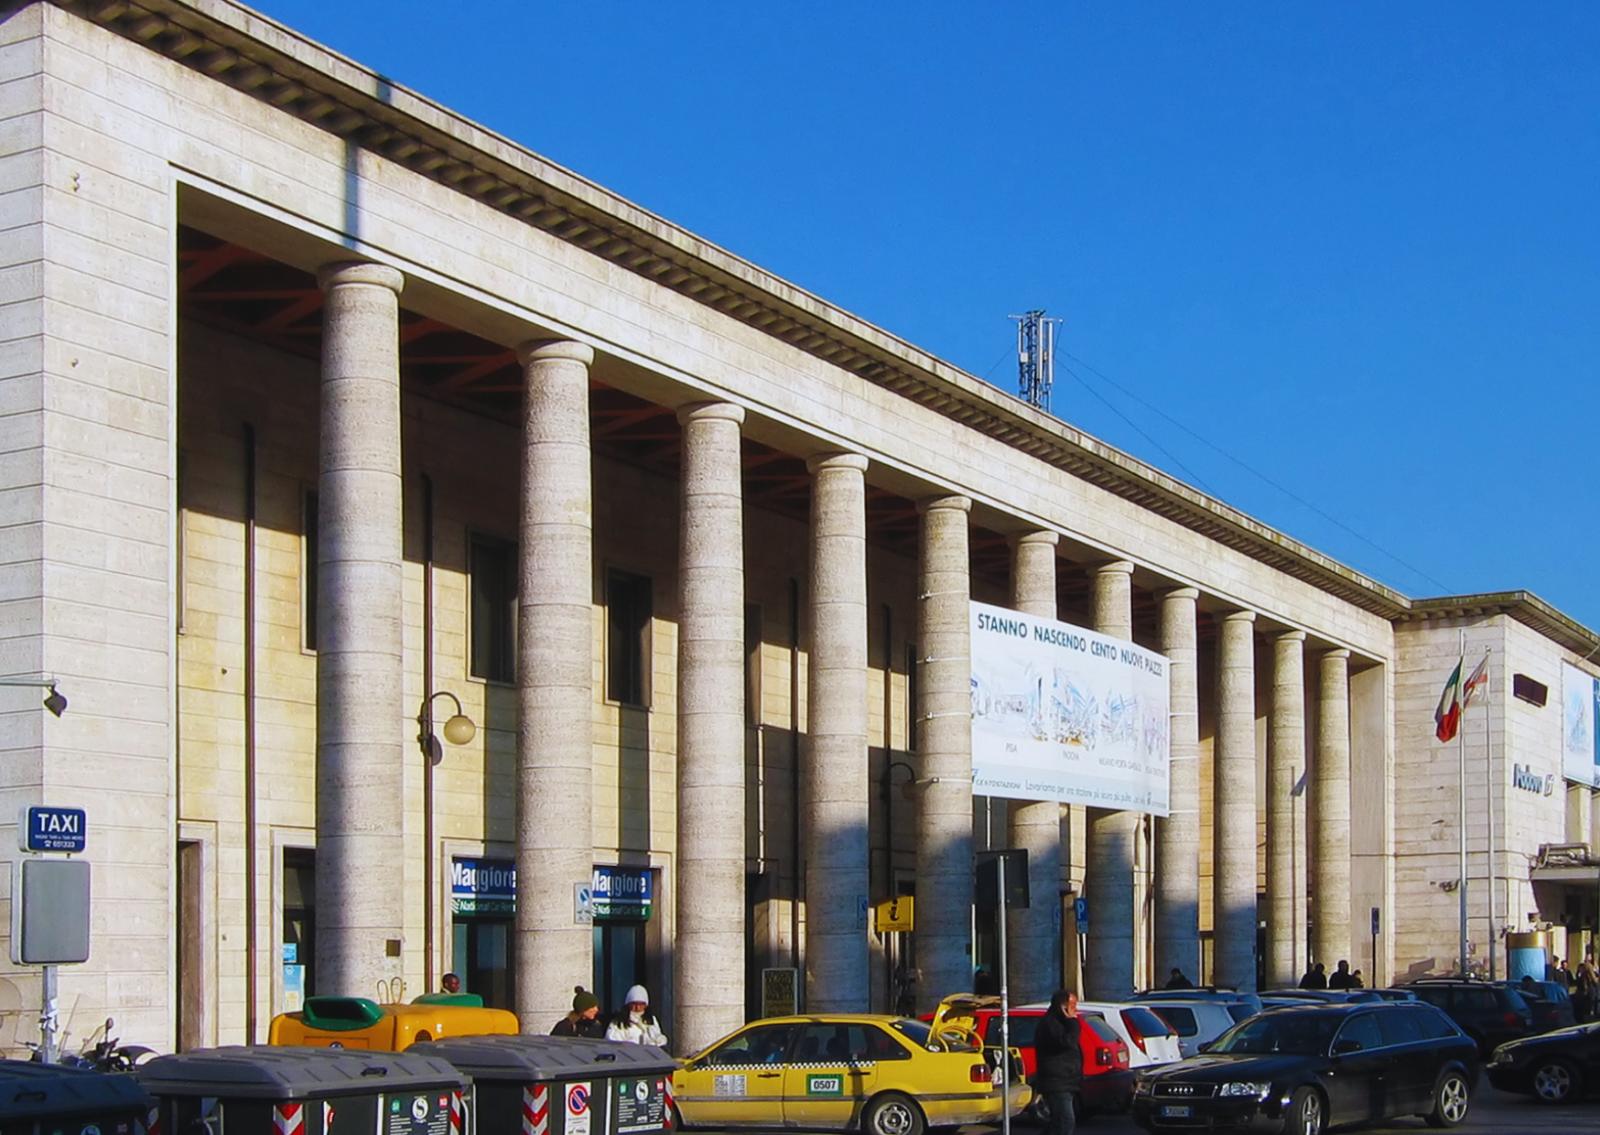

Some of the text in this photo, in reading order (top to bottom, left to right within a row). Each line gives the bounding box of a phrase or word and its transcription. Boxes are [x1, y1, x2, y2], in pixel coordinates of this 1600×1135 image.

[978, 613, 1028, 638] STANNO
[1034, 626, 1087, 652] NASCENDO
[1091, 641, 1117, 661] CENTO
[37, 813, 79, 833] TAXI
[450, 863, 516, 892] Maggiore
[592, 870, 647, 897] Maggiore
[813, 1080, 837, 1090] 0507
